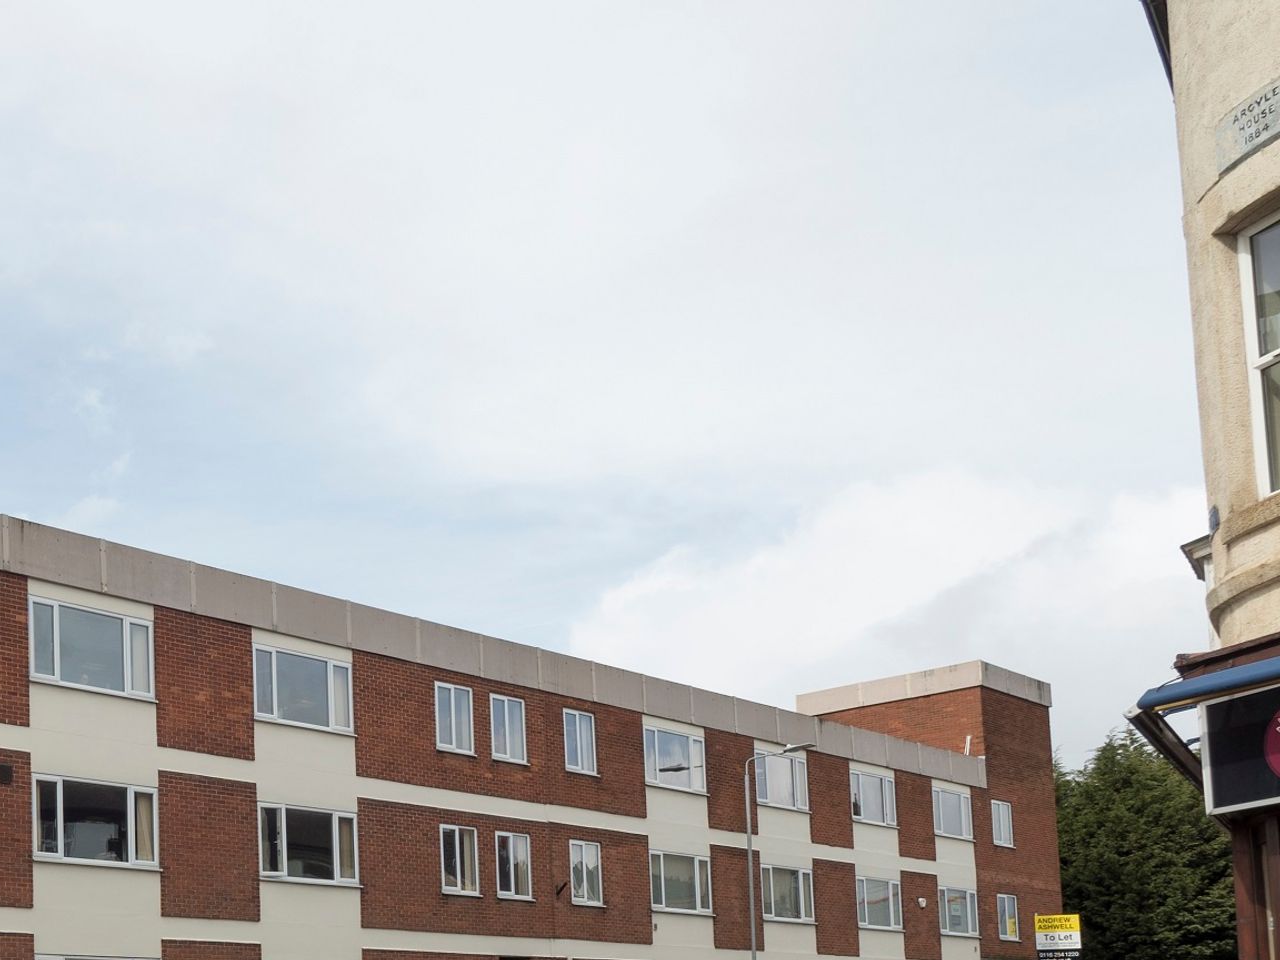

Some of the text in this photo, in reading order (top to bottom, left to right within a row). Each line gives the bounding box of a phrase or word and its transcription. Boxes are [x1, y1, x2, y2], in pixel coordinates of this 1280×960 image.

[1232, 85, 1280, 126] ARGYLE
[1239, 103, 1276, 132] HOUSE
[1037, 916, 1071, 924] ANDREW
[1044, 933, 1073, 941] To Let
